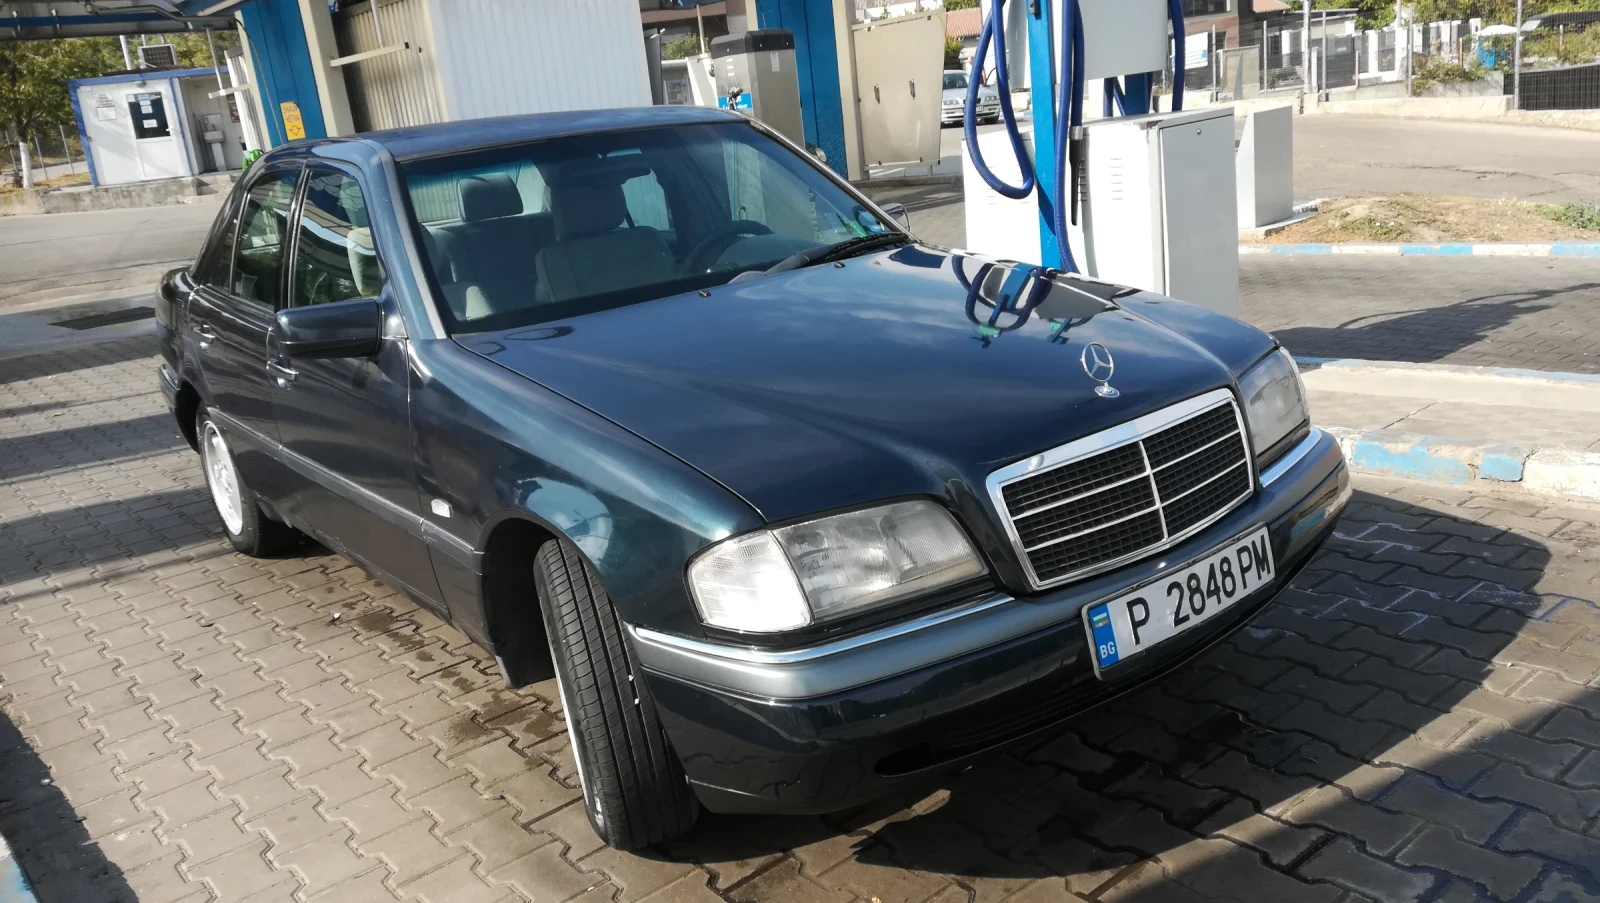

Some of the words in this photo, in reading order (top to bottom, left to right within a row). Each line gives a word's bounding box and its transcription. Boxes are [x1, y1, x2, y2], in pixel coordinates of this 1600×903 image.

[1127, 596, 1150, 646] P
[1166, 555, 1237, 628] 2848
[1236, 534, 1271, 590] PM
[1100, 641, 1115, 659] BG
